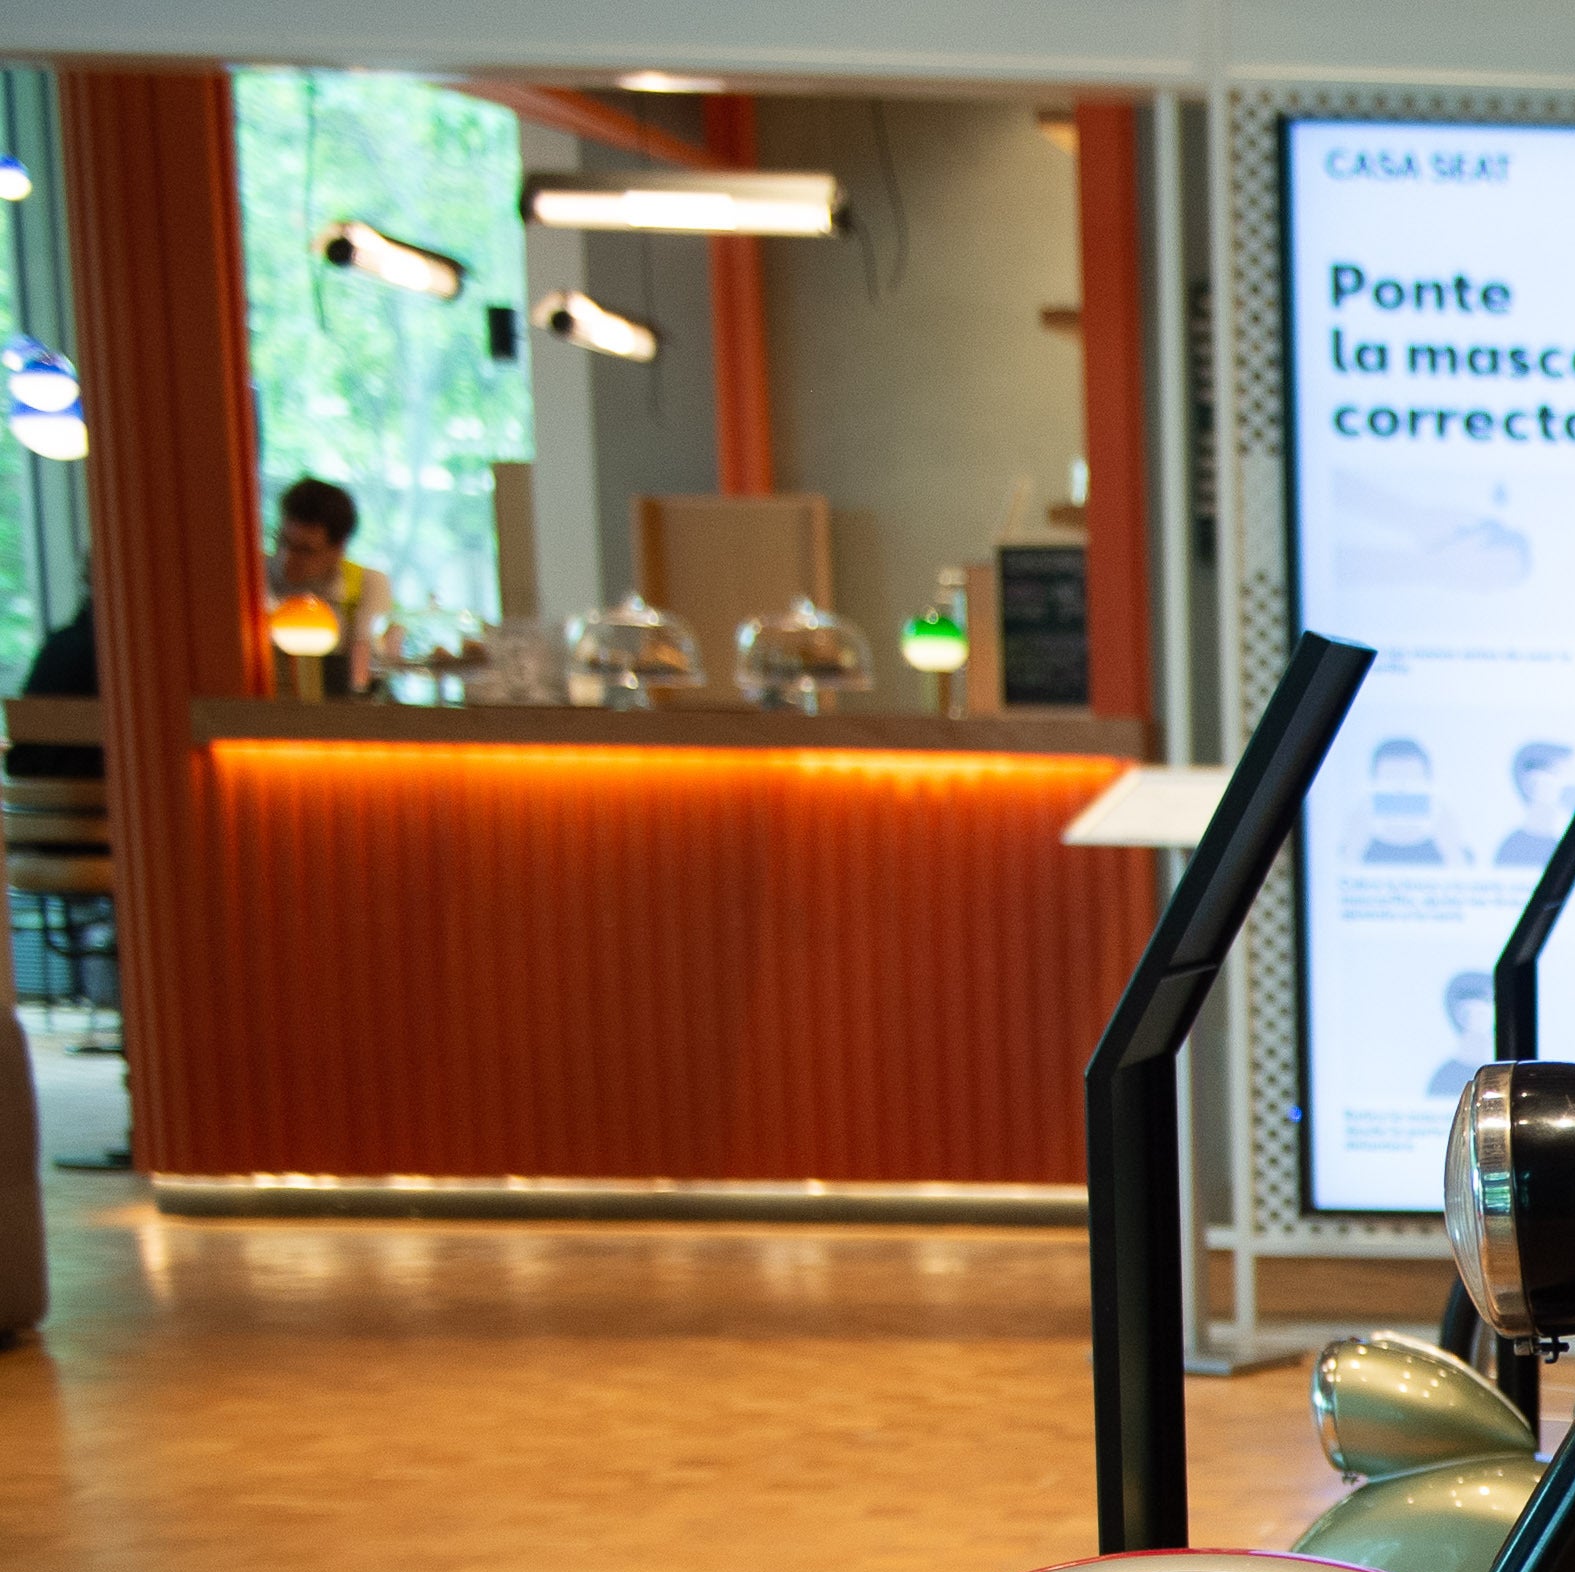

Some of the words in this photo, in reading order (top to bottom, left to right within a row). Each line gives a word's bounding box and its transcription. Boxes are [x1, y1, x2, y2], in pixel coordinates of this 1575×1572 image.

[1323, 146, 1420, 182] CASA
[1430, 151, 1511, 184] SEAT
[1328, 262, 1512, 315] Ponte
[1329, 326, 1389, 374] la
